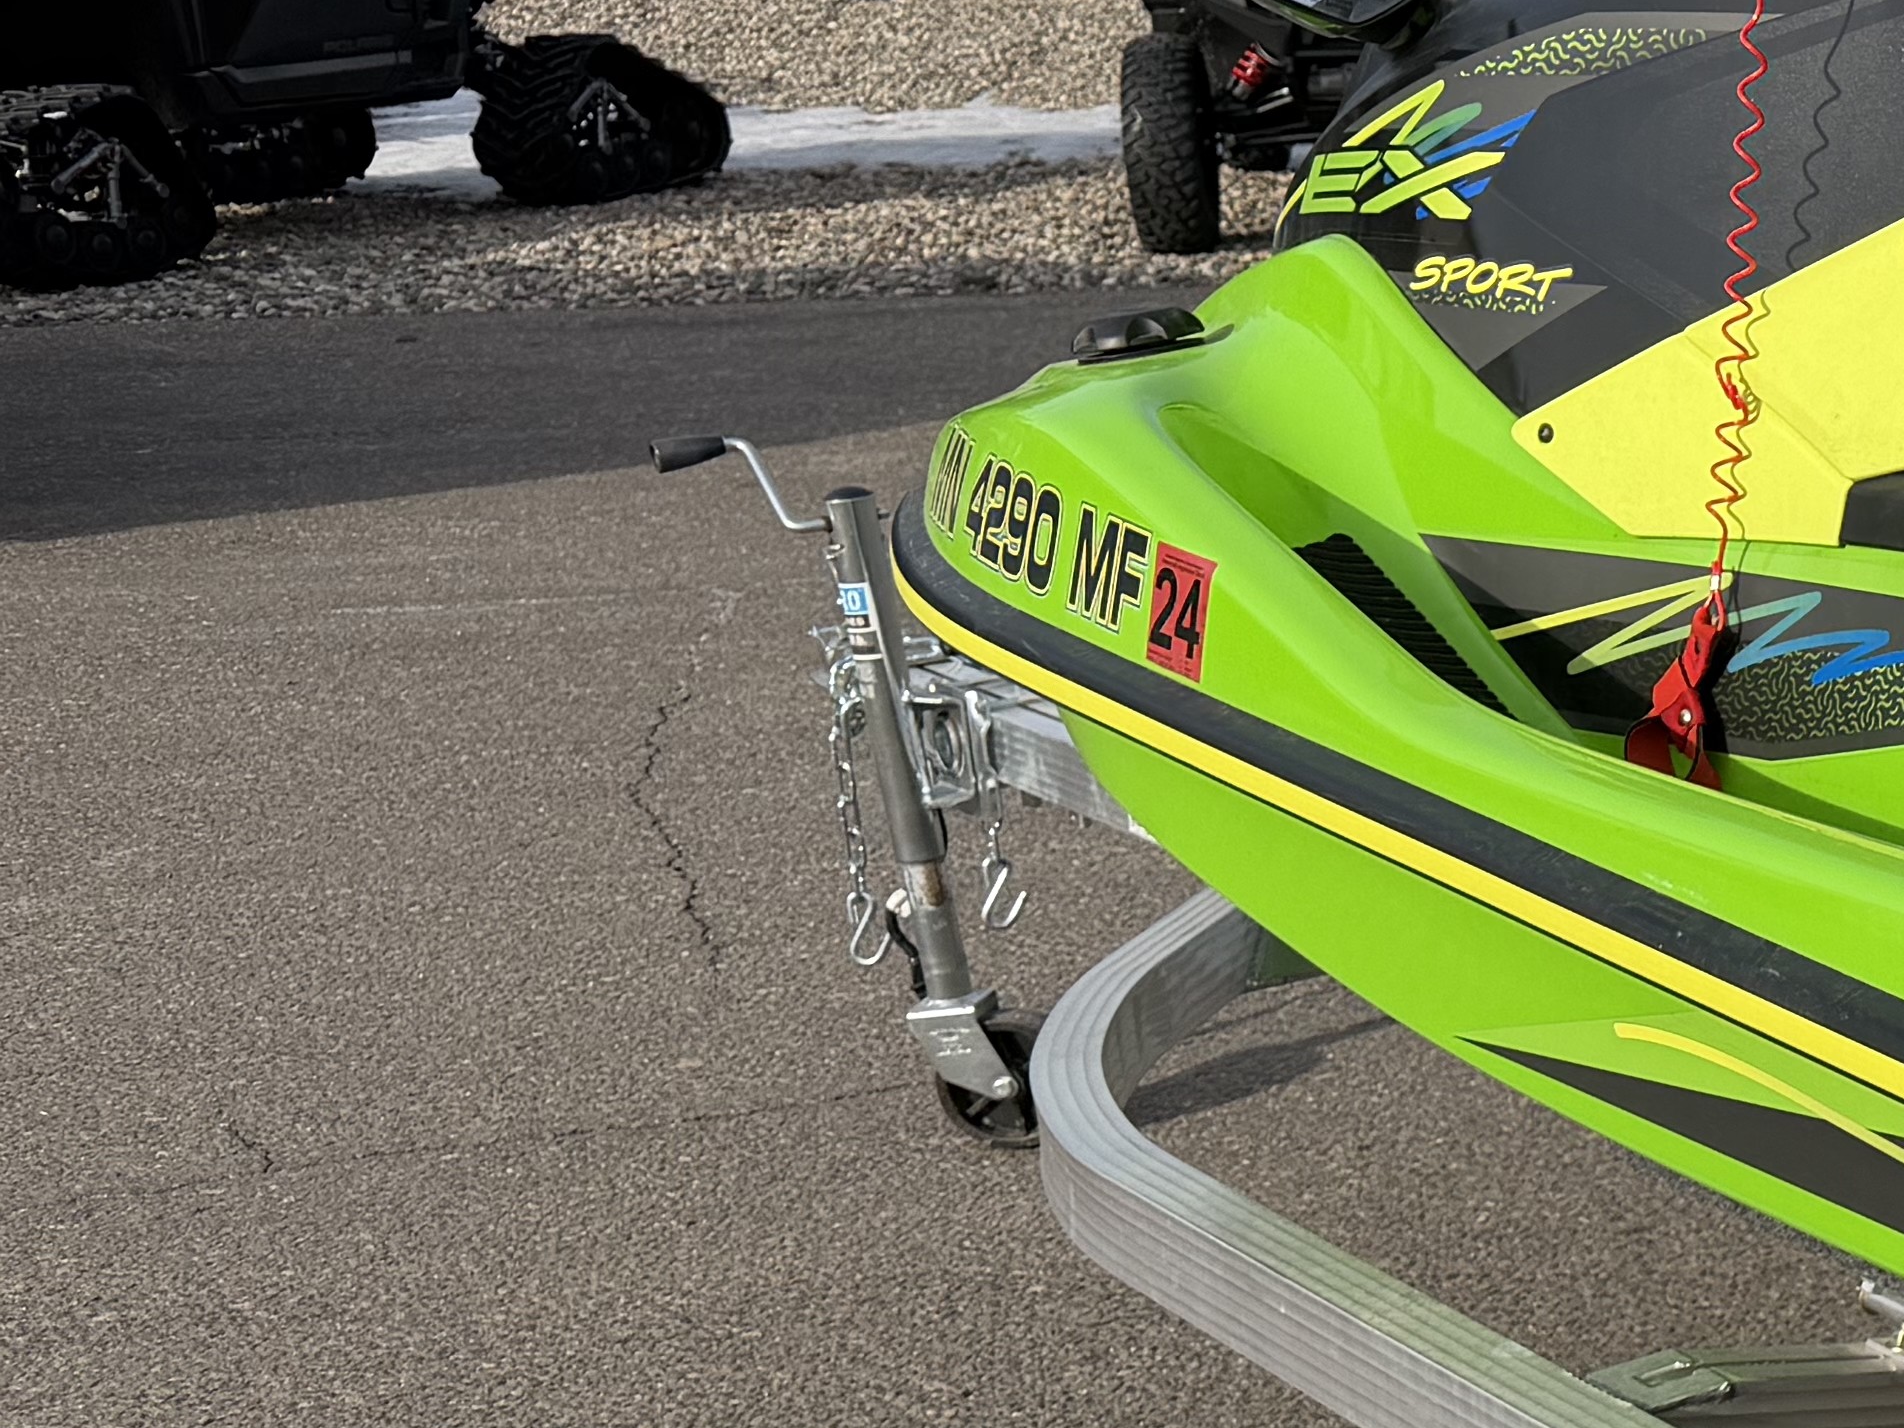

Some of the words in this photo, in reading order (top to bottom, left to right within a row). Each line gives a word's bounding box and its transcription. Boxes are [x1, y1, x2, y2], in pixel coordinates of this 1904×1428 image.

[1299, 149, 1506, 220] EX
[1409, 255, 1574, 302] SPORT
[930, 422, 977, 541] MN
[964, 453, 1064, 597] 4290
[1067, 501, 1153, 635] MF
[1150, 567, 1202, 659] 24
